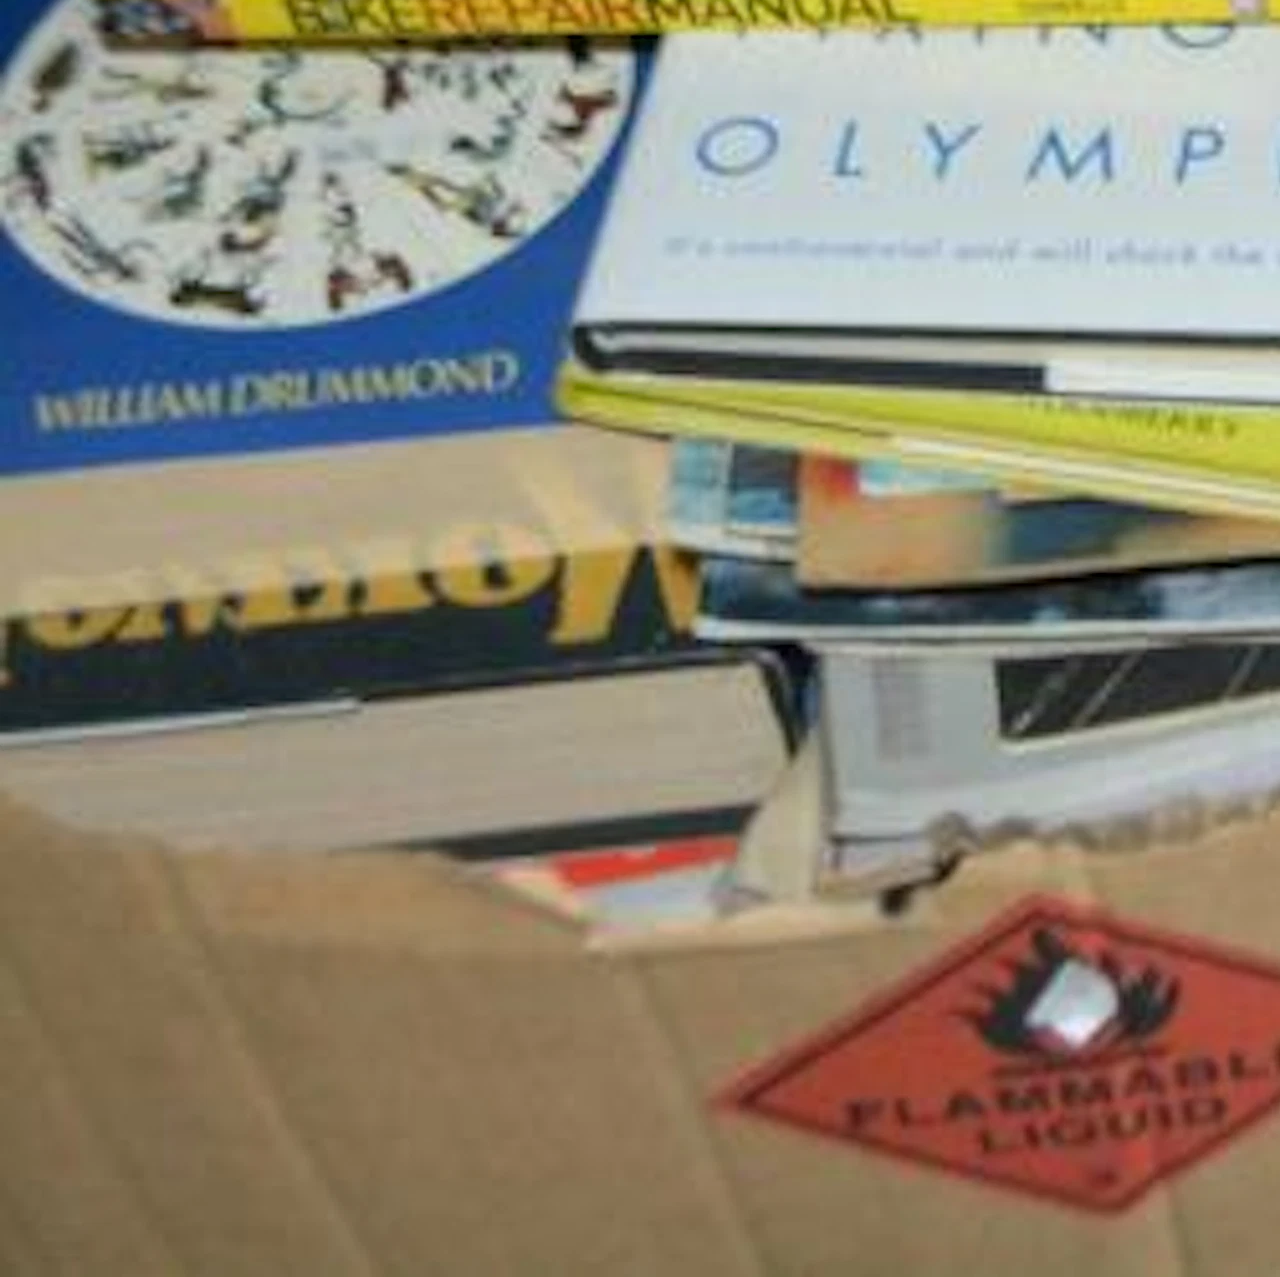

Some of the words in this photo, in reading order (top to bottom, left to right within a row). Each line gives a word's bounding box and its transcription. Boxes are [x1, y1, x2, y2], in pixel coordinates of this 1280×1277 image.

[33, 374, 221, 434] WILLIAM
[226, 350, 520, 416] DRUMMOND
[979, 1094, 1228, 1154] LIQUID
